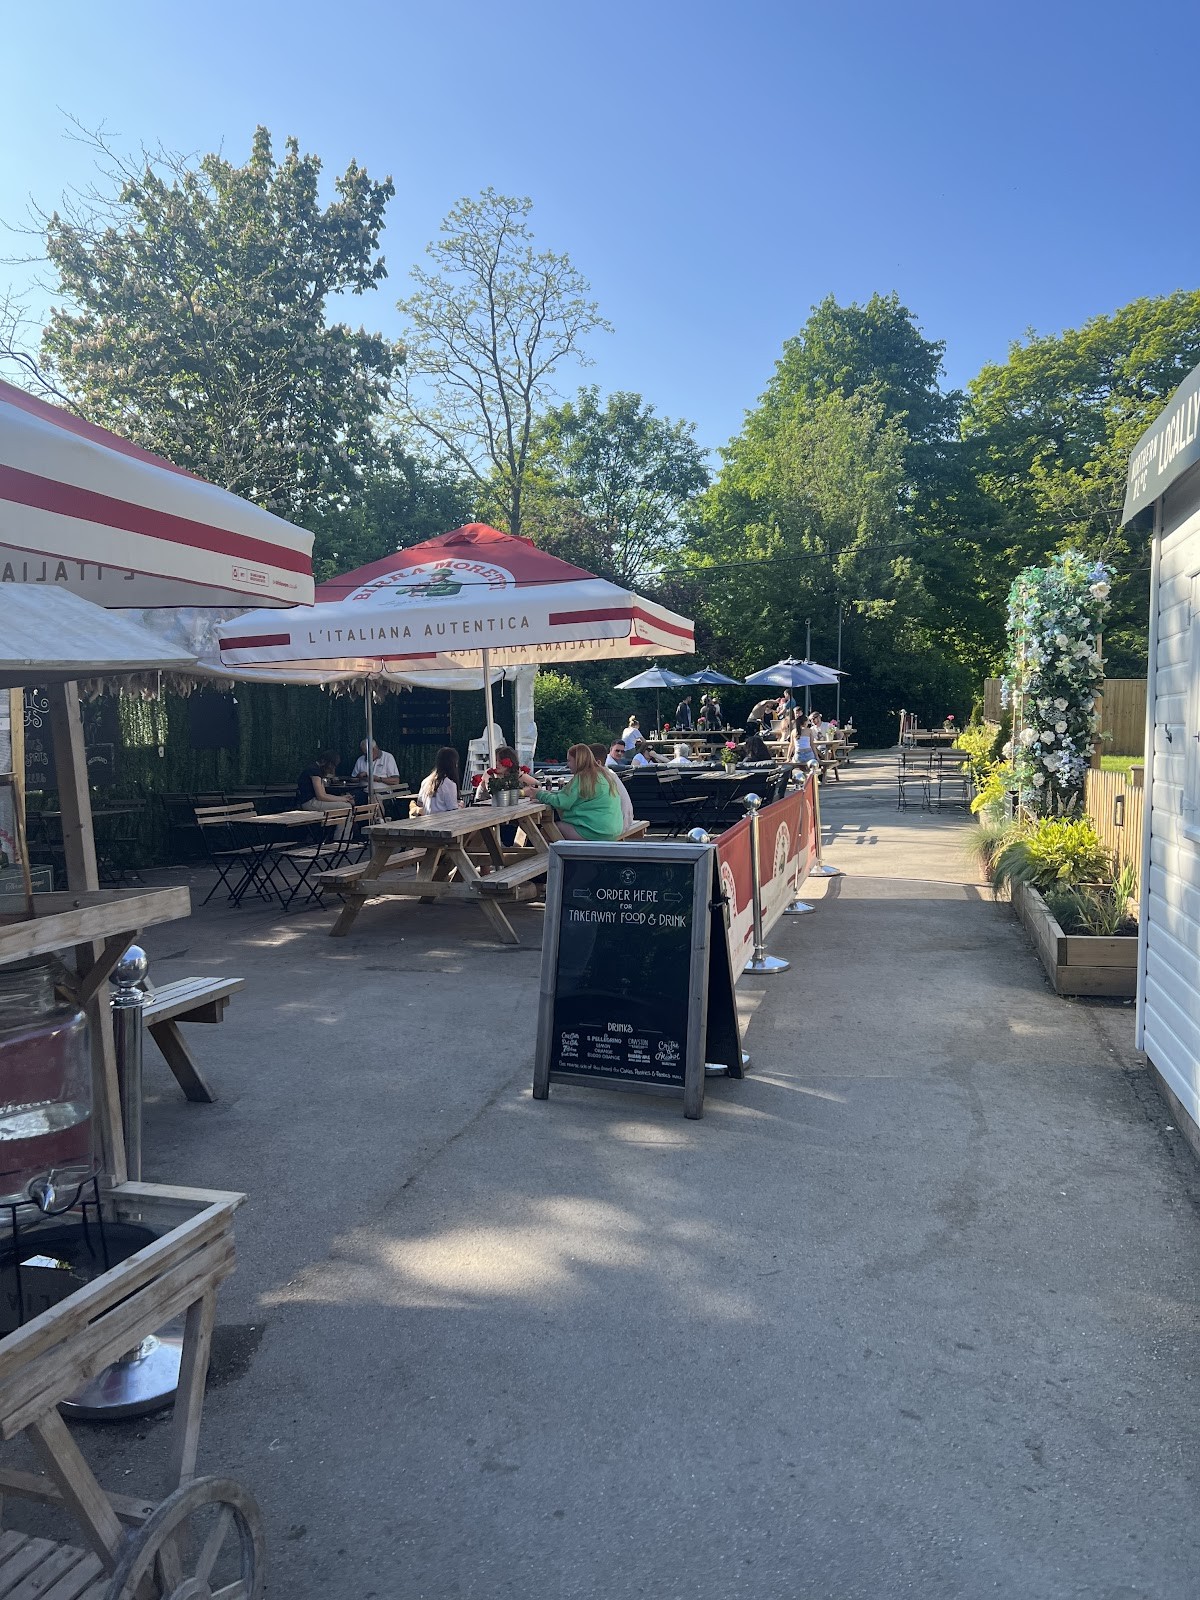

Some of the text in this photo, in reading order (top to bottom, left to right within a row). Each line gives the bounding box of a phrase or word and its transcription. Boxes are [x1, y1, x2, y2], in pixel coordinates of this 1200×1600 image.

[1157, 387, 1200, 476] LOCALLY
[352, 559, 507, 601] BIRRA MORETTI
[308, 615, 530, 644] L'ITALIANA AUTENTICA
[596, 888, 658, 903] ORDER HERE
[568, 909, 686, 928] TAKEAWAY FOOD & DRINK
[607, 1022, 634, 1034] DRINKS
